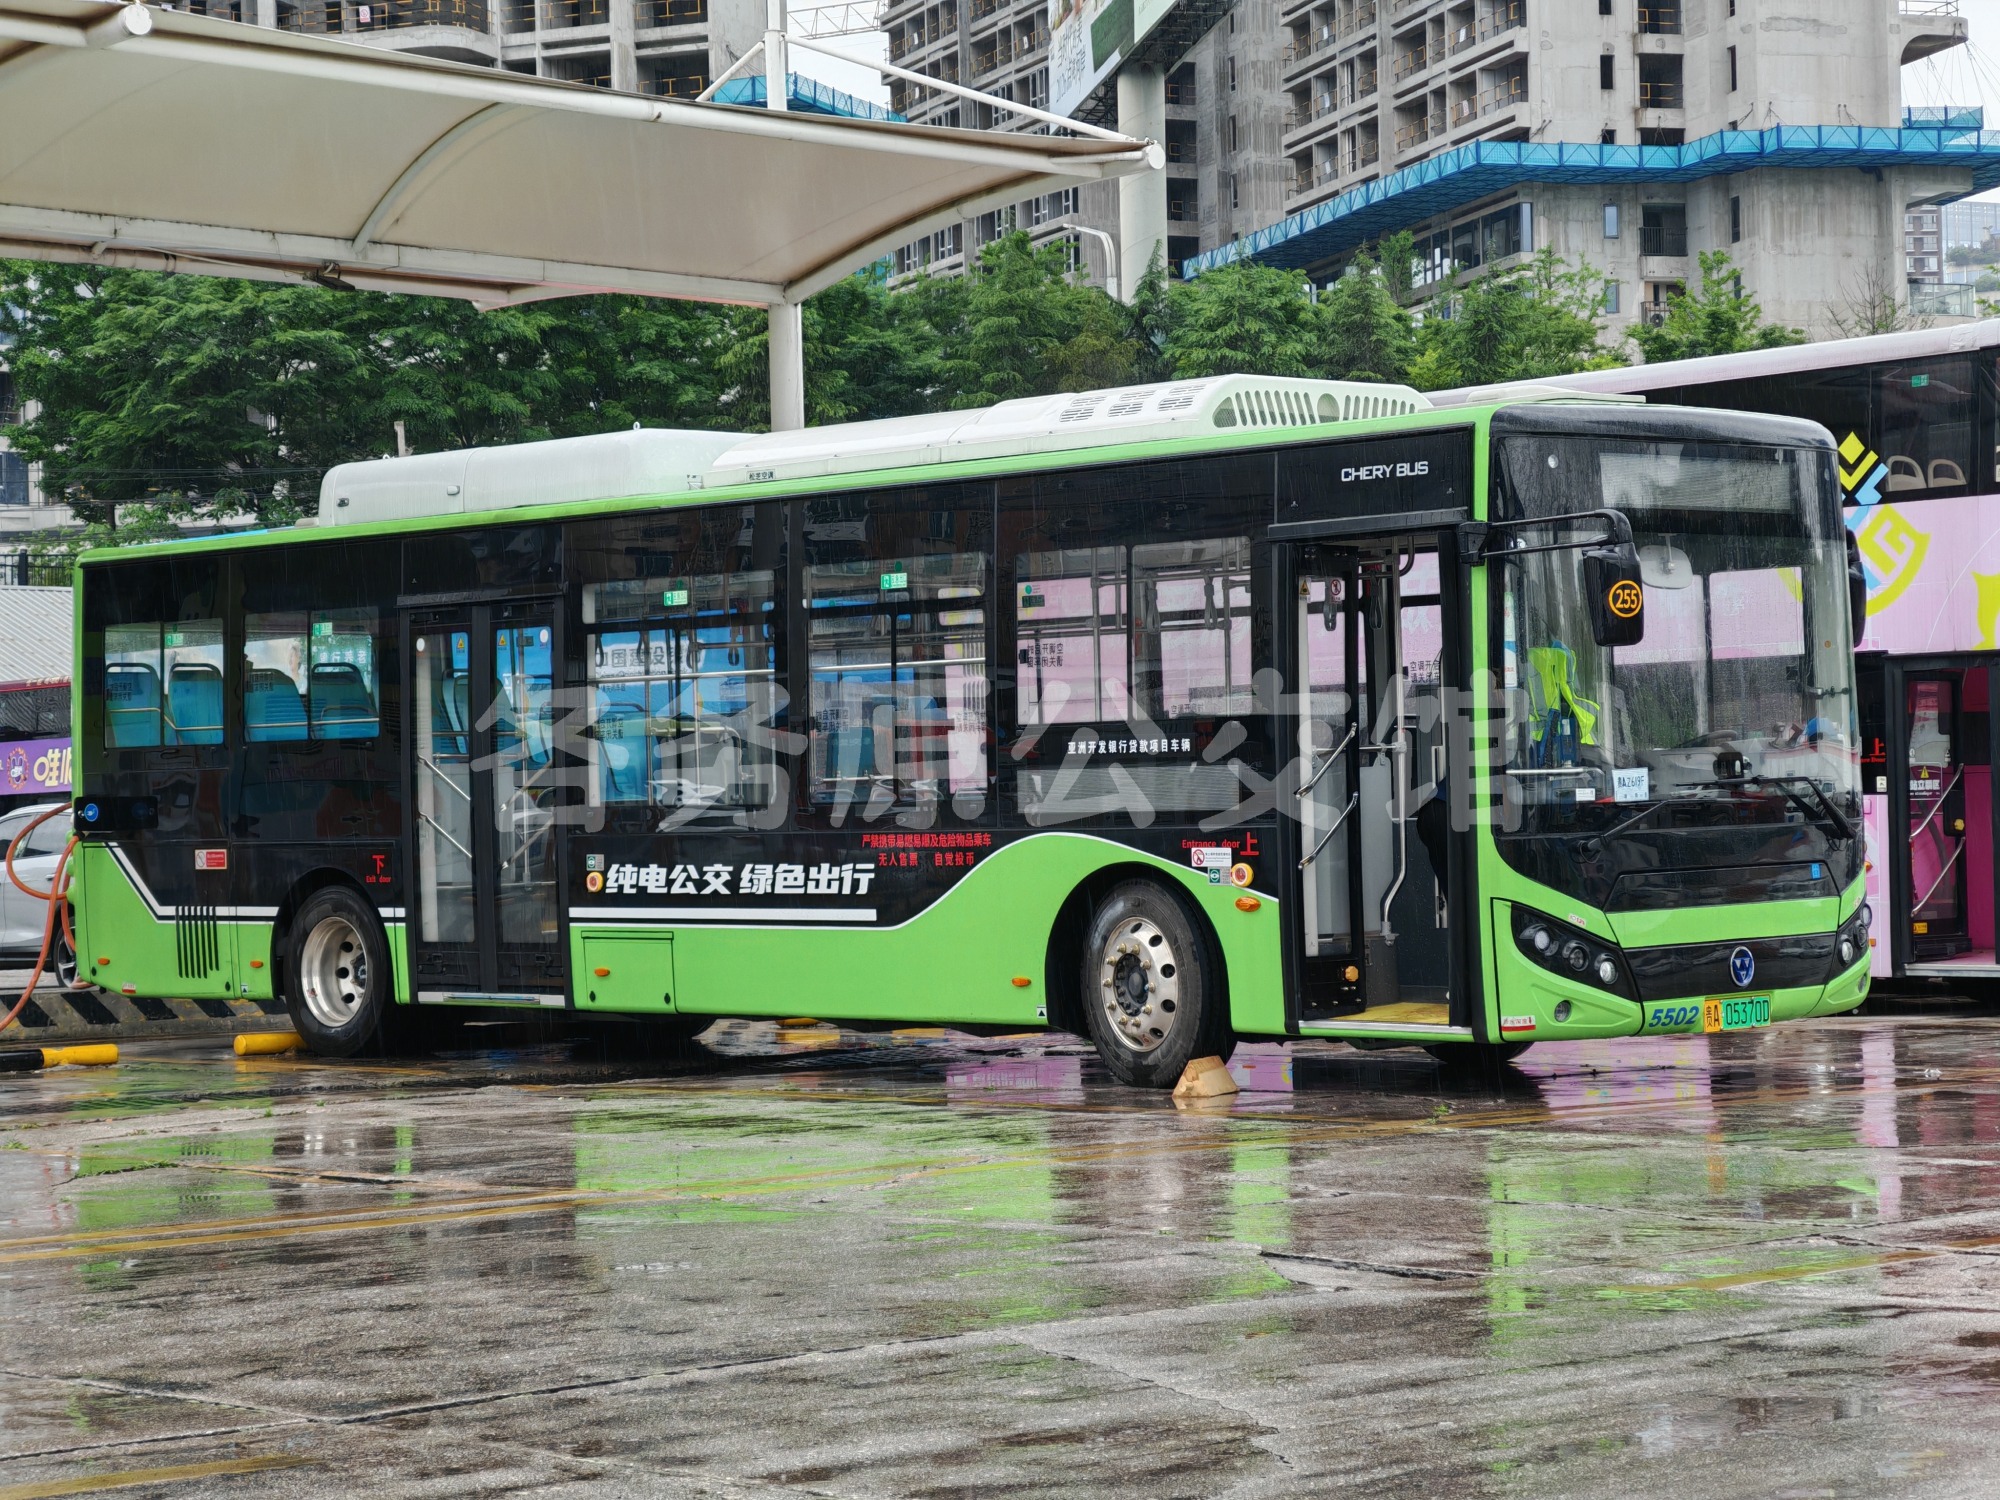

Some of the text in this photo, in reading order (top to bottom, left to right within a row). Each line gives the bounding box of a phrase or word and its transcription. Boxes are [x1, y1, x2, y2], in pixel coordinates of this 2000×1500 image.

[749, 471, 774, 480] 松芝空调
[1341, 461, 1428, 481] CHERY BUS
[1615, 589, 1637, 609] 255
[1067, 738, 1191, 755] 亚洲开发银行贷款项目车辆
[862, 832, 992, 848] 严禁携带易燃易爆及危险物品乘车
[1182, 838, 1240, 849] Entrance door
[1240, 831, 1259, 856] 上
[372, 854, 385, 875] 下
[878, 851, 975, 867] 无人售票 自觉投币
[605, 863, 875, 895] 纯电公交 绿色出行
[1649, 1005, 1699, 1028] 5502
